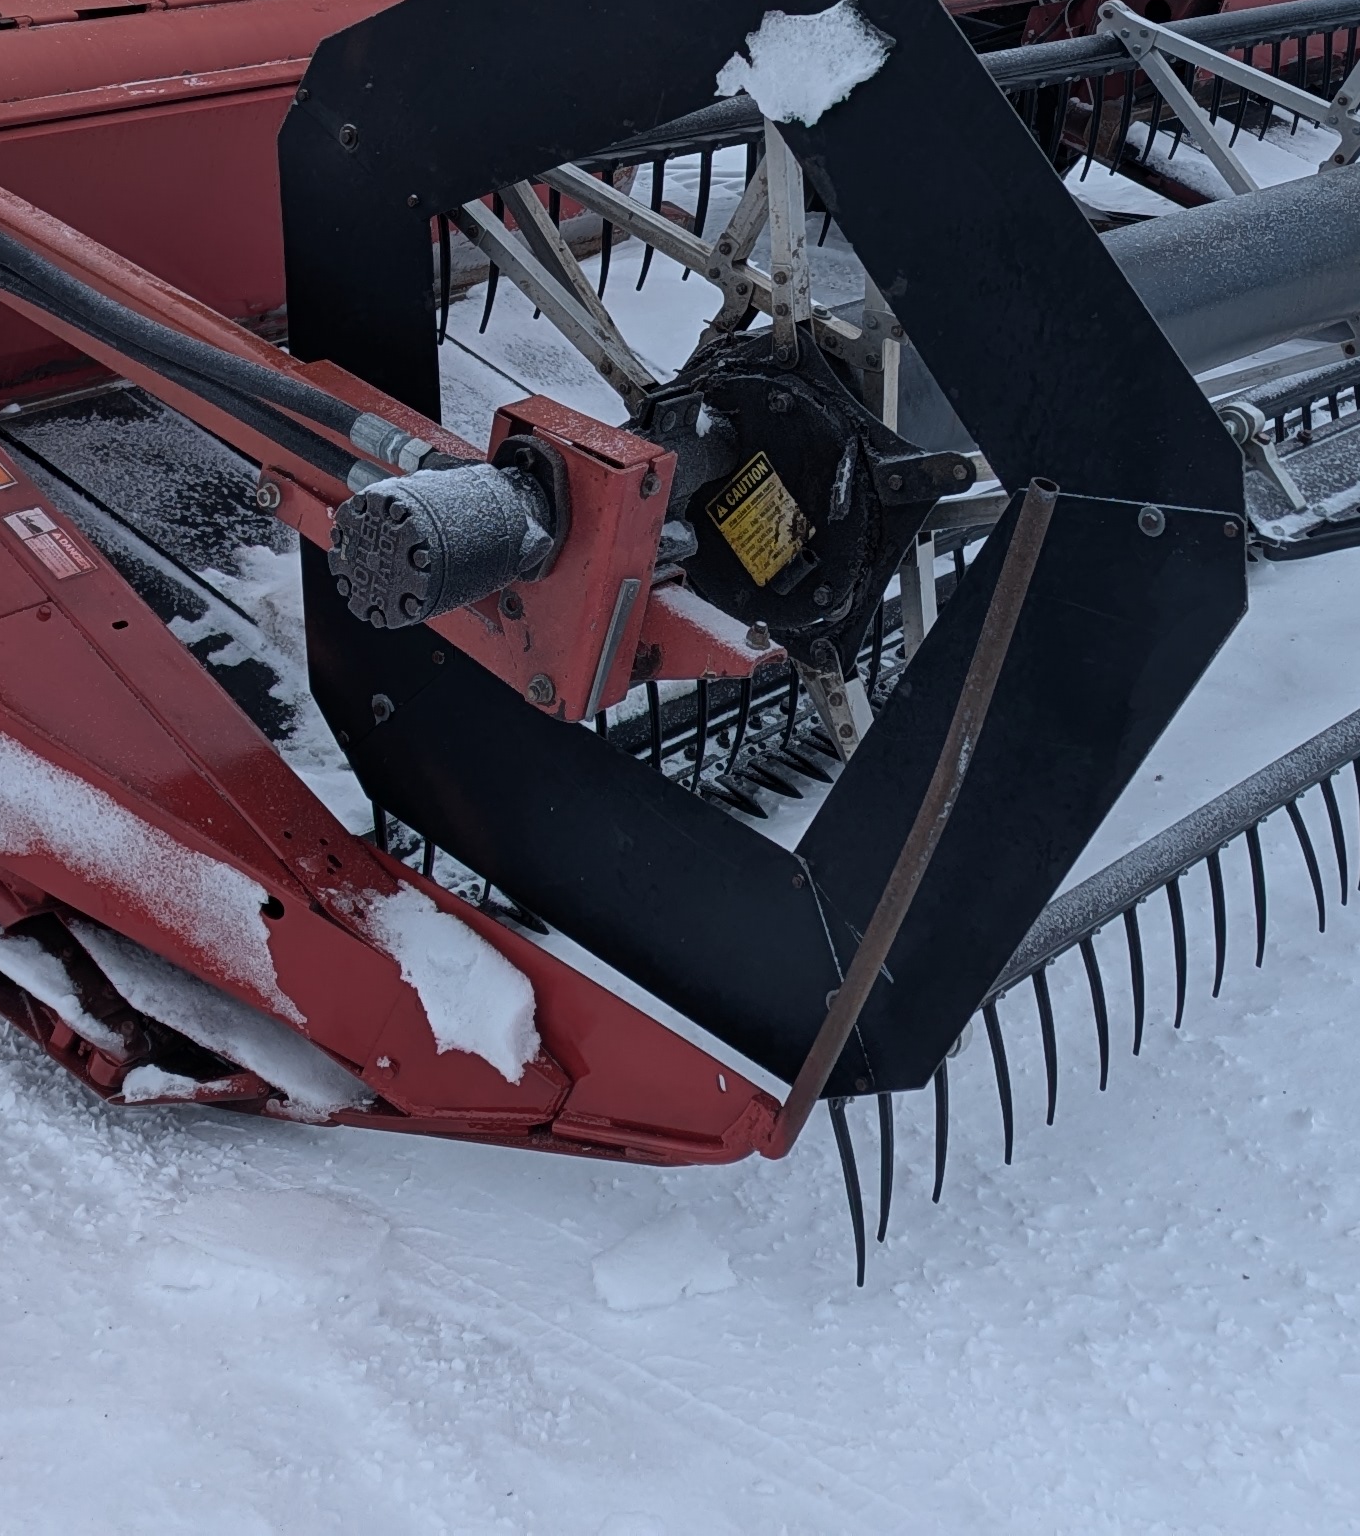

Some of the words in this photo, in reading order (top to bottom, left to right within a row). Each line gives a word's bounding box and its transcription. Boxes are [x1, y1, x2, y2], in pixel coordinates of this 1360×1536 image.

[725, 460, 769, 506] CAUTION
[59, 538, 91, 569] DANGER
[351, 511, 380, 602] ROLLER
[370, 520, 397, 609] STATOR
